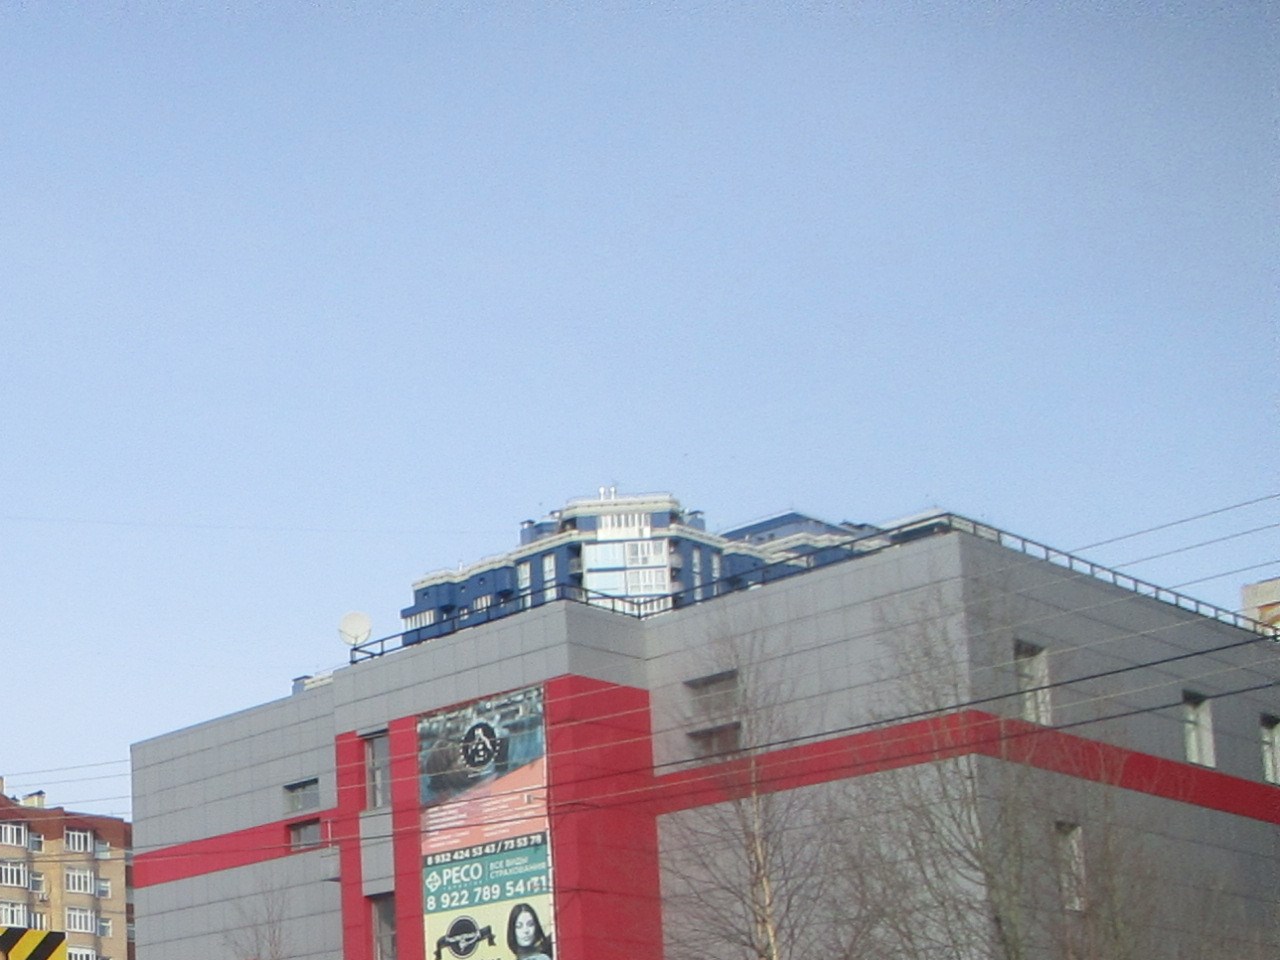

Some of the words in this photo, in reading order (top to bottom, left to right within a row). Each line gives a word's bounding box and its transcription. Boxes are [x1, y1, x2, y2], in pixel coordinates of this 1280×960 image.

[442, 862, 483, 885] РЕСО
[426, 895, 436, 910] 8
[441, 890, 470, 908] 922
[473, 884, 501, 903] 789
[505, 880, 525, 897] 54
